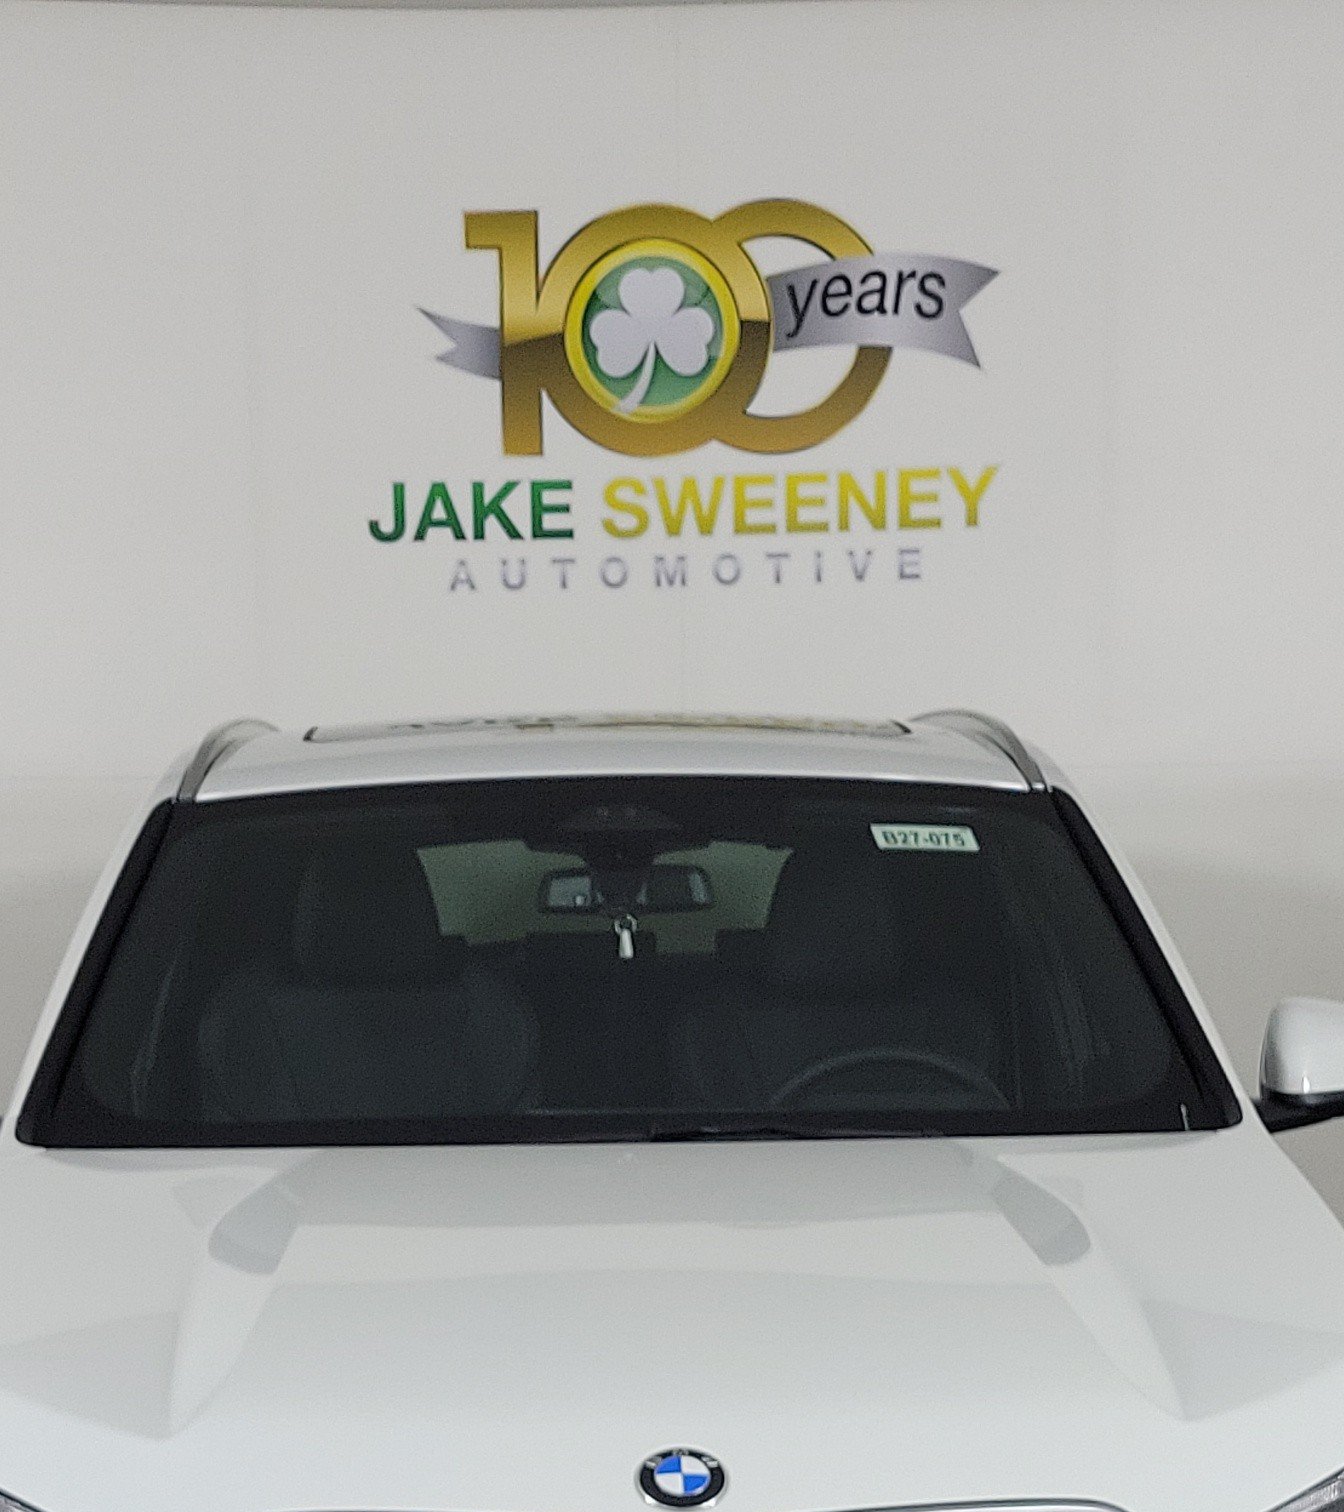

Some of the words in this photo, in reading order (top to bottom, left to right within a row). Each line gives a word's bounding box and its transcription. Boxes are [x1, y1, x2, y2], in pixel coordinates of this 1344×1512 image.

[463, 198, 893, 457] 100
[785, 266, 946, 339] years
[368, 479, 574, 544] JAKE
[601, 466, 999, 538] SWEENEY
[450, 548, 922, 591] AUTOMOTIVE
